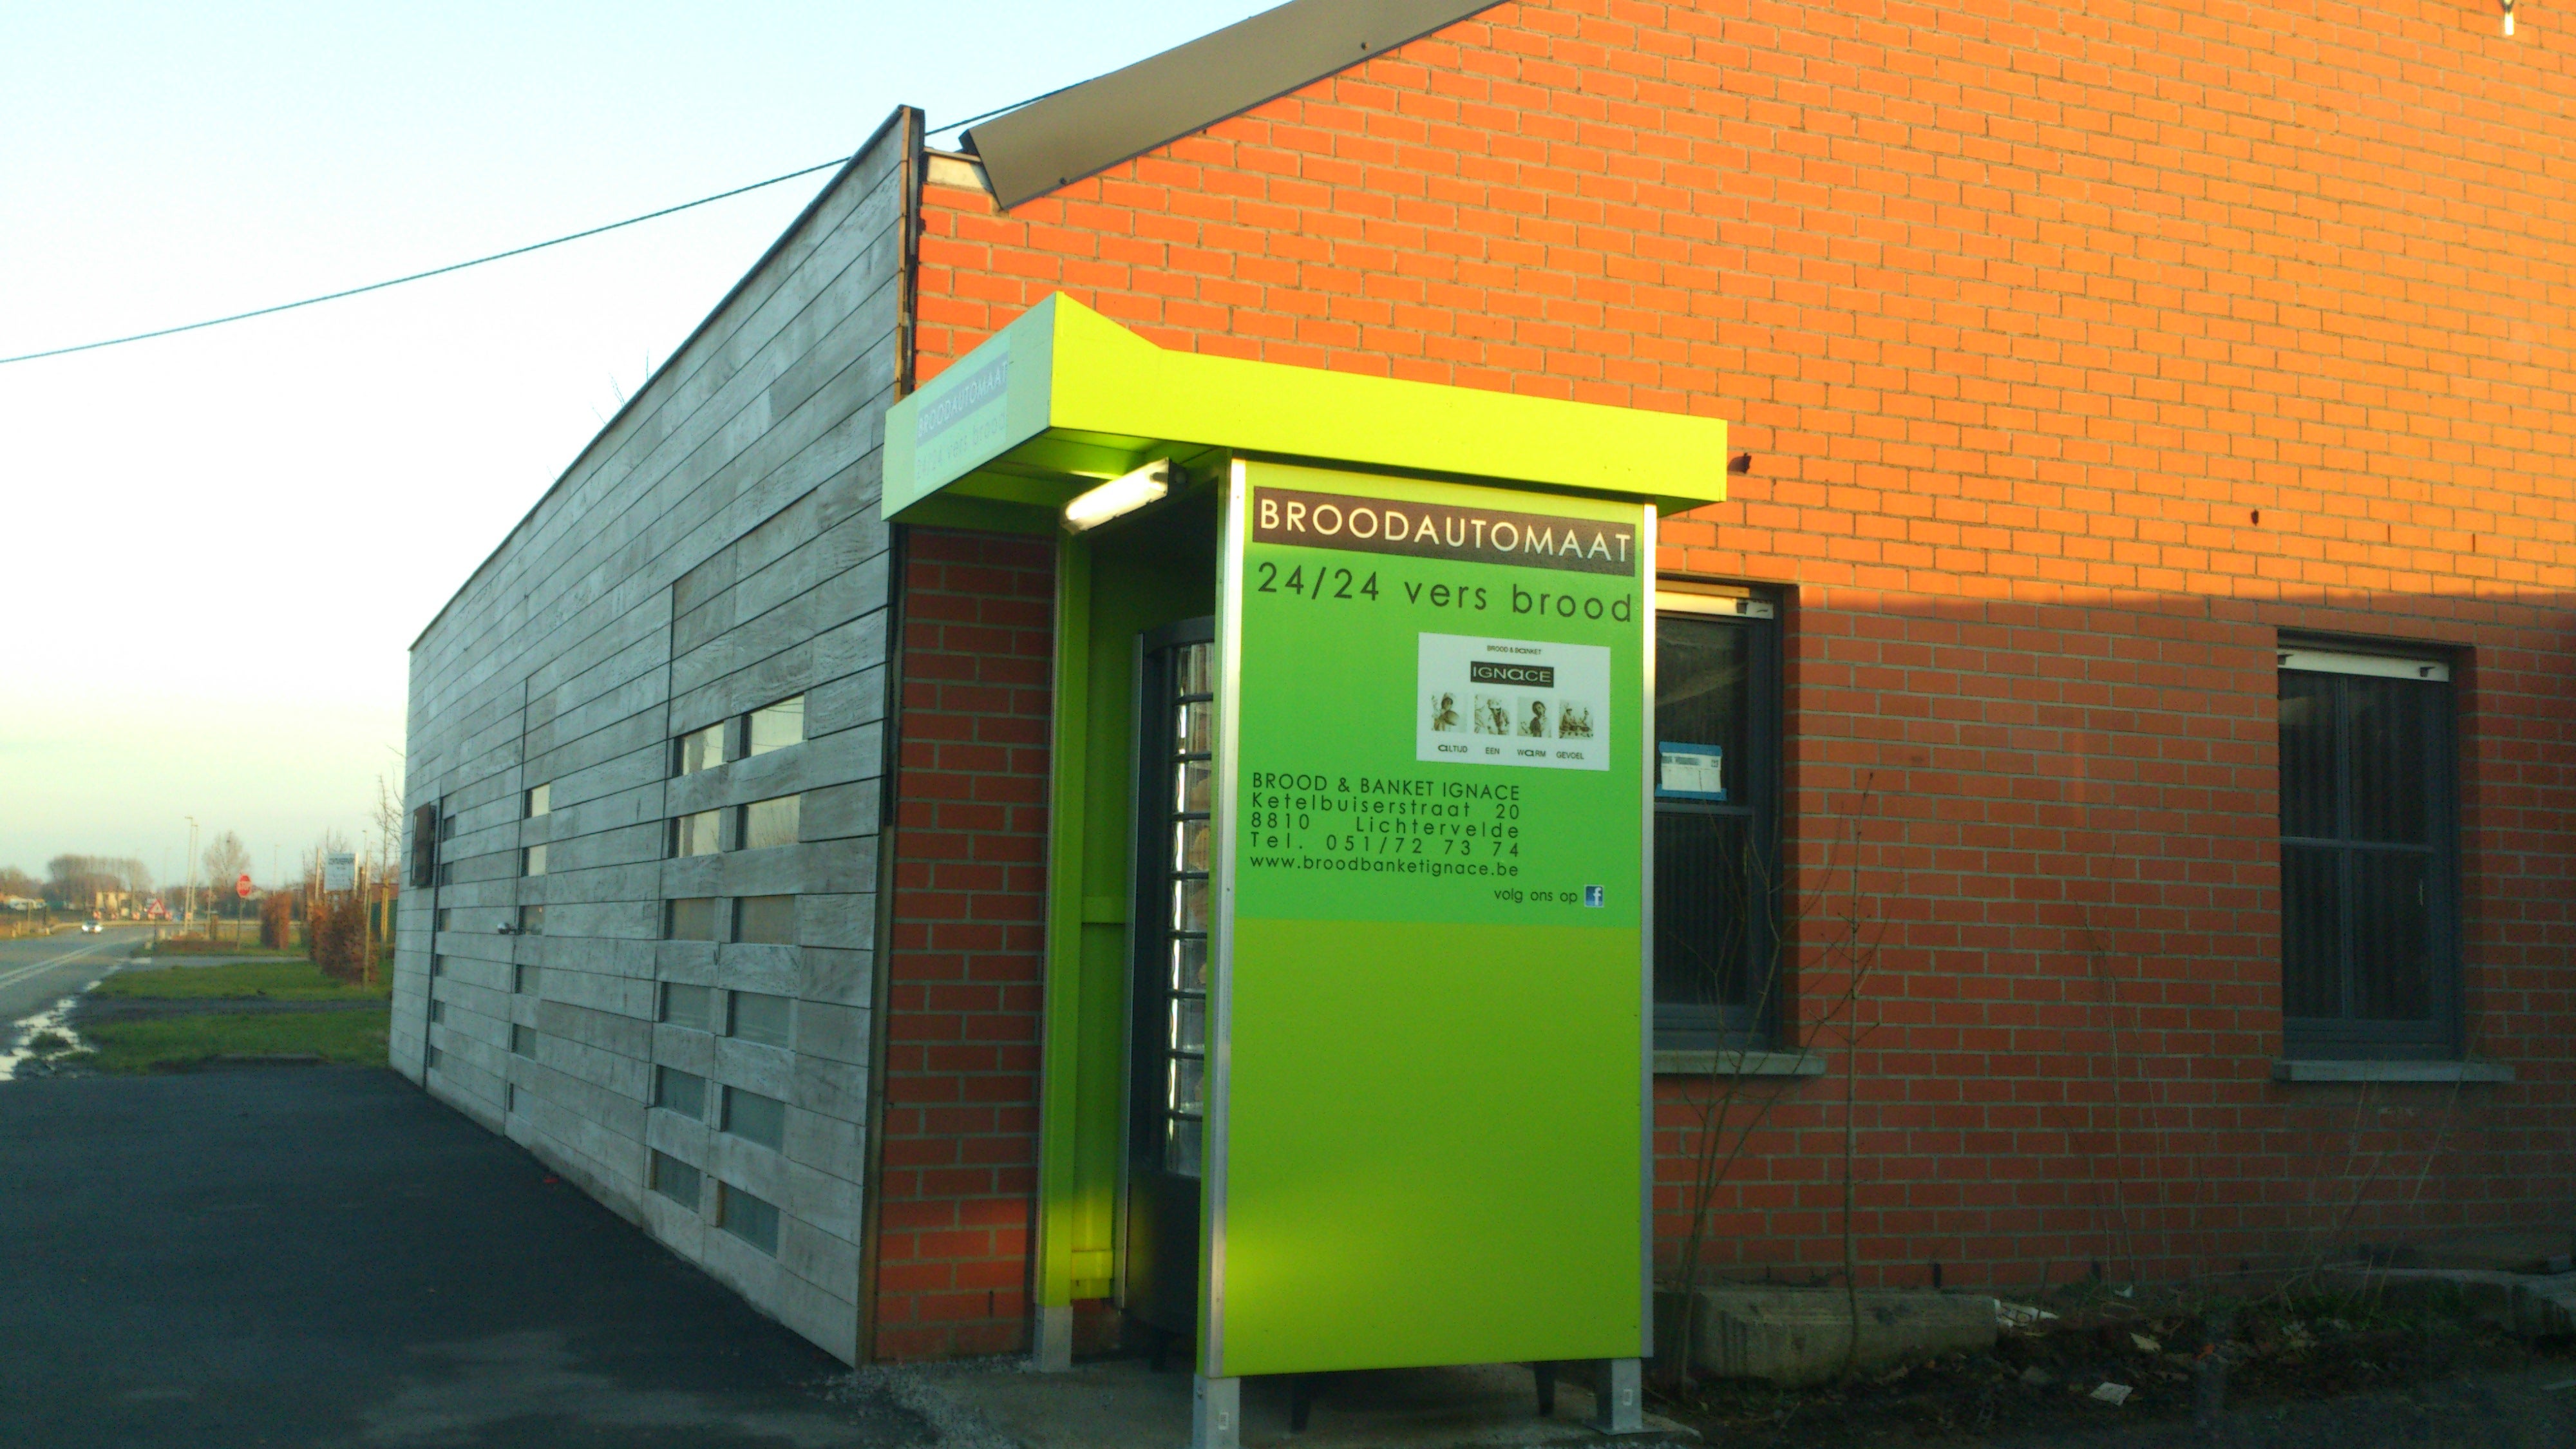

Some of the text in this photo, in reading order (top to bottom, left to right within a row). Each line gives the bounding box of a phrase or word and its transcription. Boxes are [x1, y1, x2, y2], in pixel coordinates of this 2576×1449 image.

[918, 361, 1009, 438] BROODAUTOMAAT
[1260, 498, 1631, 562] BROODAUTOMAAT
[1258, 562, 1631, 623] 24/24 vers brood
[1556, 750, 1584, 759] GEVOEL
[1253, 773, 1520, 801] BROOD & BANKET IGNACE
[1252, 792, 1520, 820] Ketelbuiserstraat 20
[1251, 811, 1519, 838] 8810 Lichtervelde
[1251, 831, 1519, 857] Tel. 051/72 73 74
[1250, 855, 1519, 877] www.broodbanketignace.be
[1494, 887, 1523, 904] volg
[1530, 891, 1553, 902] ons
[1560, 892, 1578, 905] op
